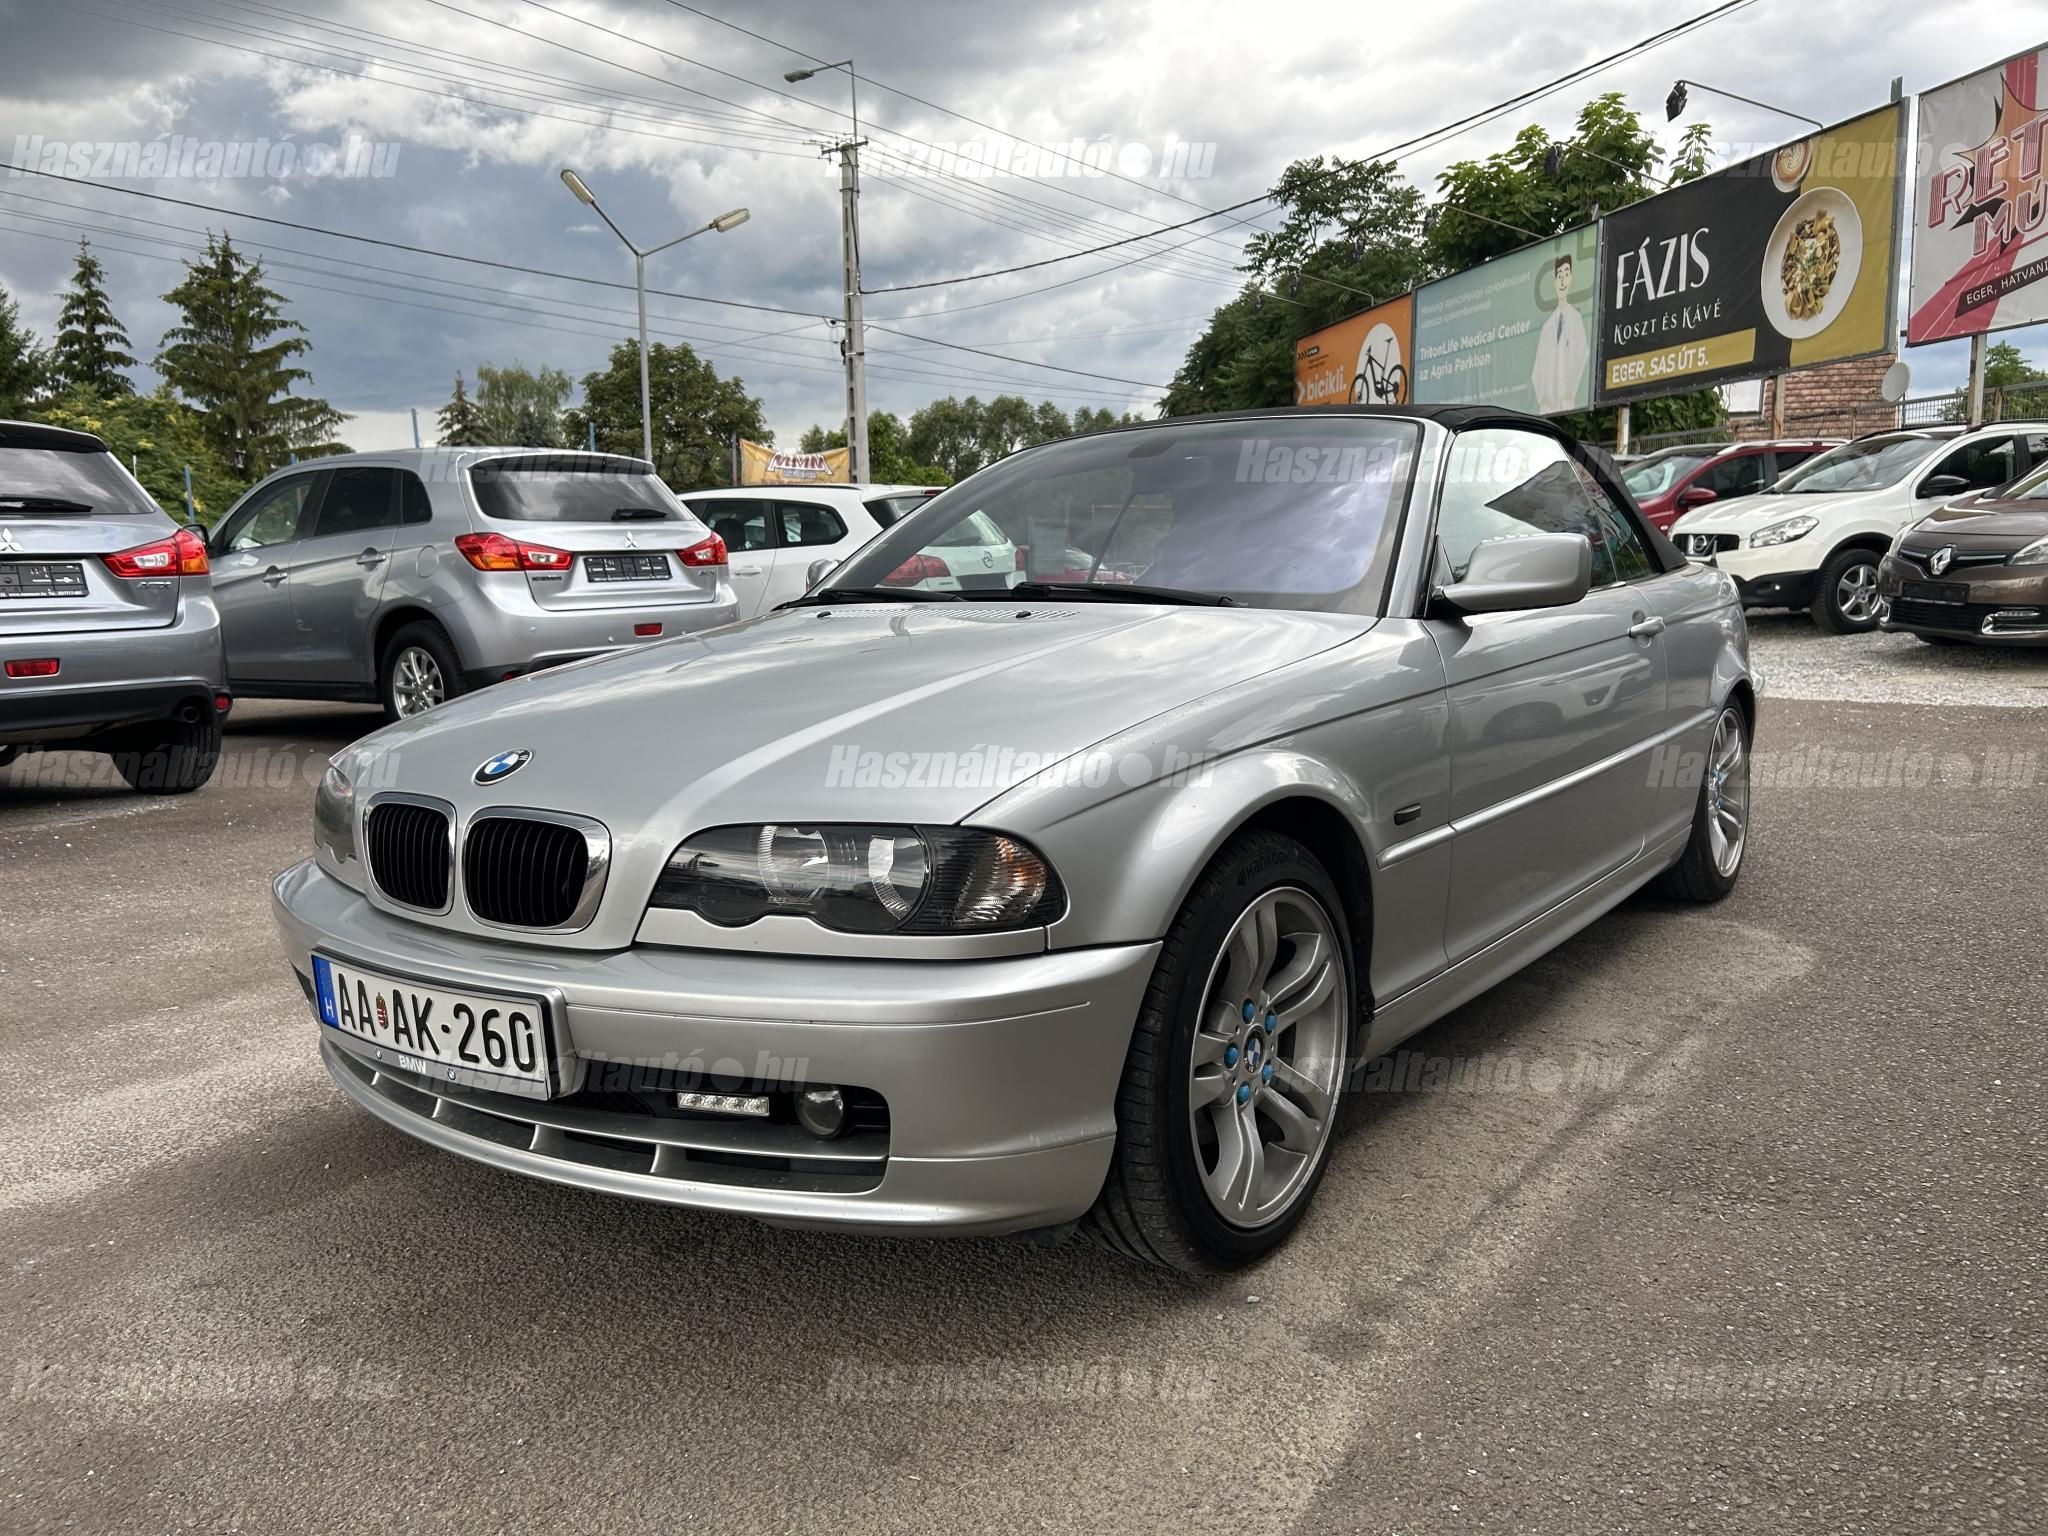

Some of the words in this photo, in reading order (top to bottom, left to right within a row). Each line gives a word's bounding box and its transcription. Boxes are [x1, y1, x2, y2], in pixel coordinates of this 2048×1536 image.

[1616, 227, 1710, 309] FÁZIS
[1966, 284, 1997, 304] EGER,
[2001, 260, 2048, 289] HATVANI
[1420, 338, 1459, 360] TritonLife
[1460, 328, 1496, 350] Medical
[1498, 320, 1531, 339] Center
[1614, 318, 1657, 345] KOSZT
[1662, 311, 1677, 331] ÉS
[1682, 298, 1722, 329] KÁVÉ
[1419, 369, 1429, 381] az
[1430, 361, 1453, 380] Agria
[1454, 353, 1491, 372] Parkban
[1612, 361, 1647, 383] EGER,
[1650, 353, 1675, 376] SAS
[1678, 345, 1697, 370] ÚT
[1698, 347, 1709, 366] 5.
[399, 1055, 426, 1074] BMW
